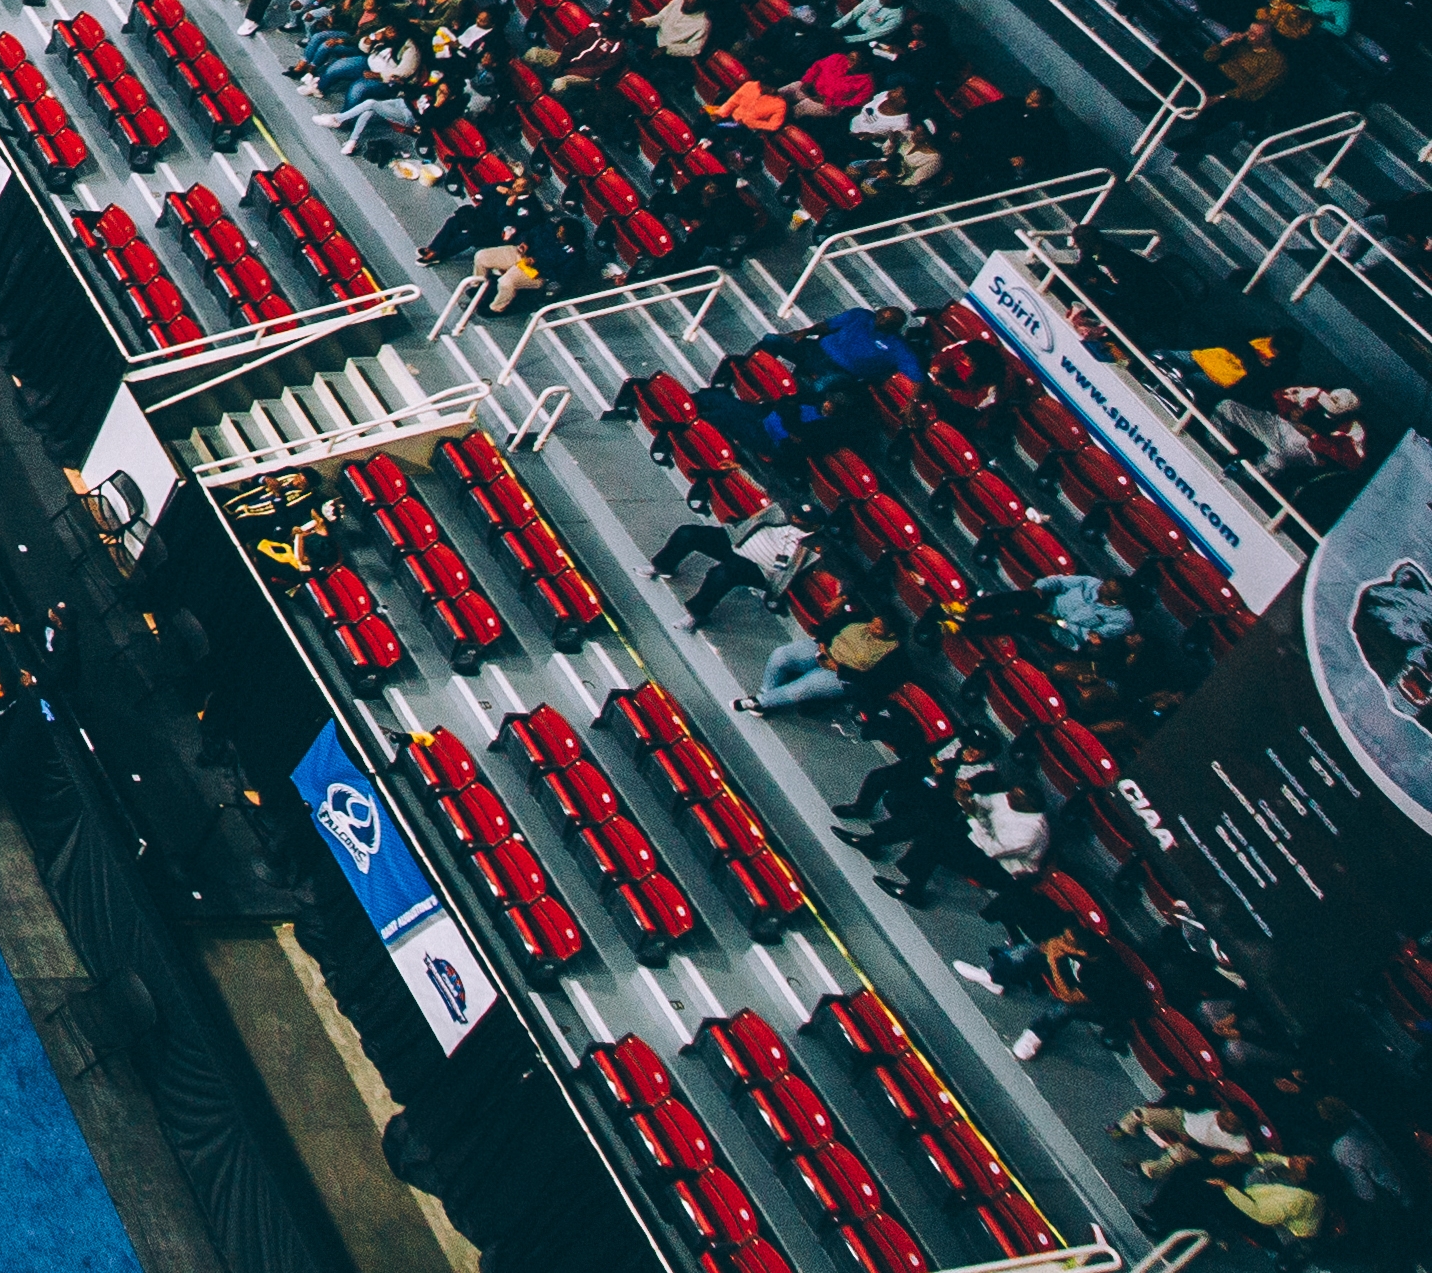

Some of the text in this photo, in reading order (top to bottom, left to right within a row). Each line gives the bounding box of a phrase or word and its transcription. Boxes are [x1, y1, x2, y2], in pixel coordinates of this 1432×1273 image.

[988, 276, 1241, 551] Spirit www.spiritcom.com
[316, 808, 371, 874] FALCONS
[1118, 779, 1178, 852] CIAA
